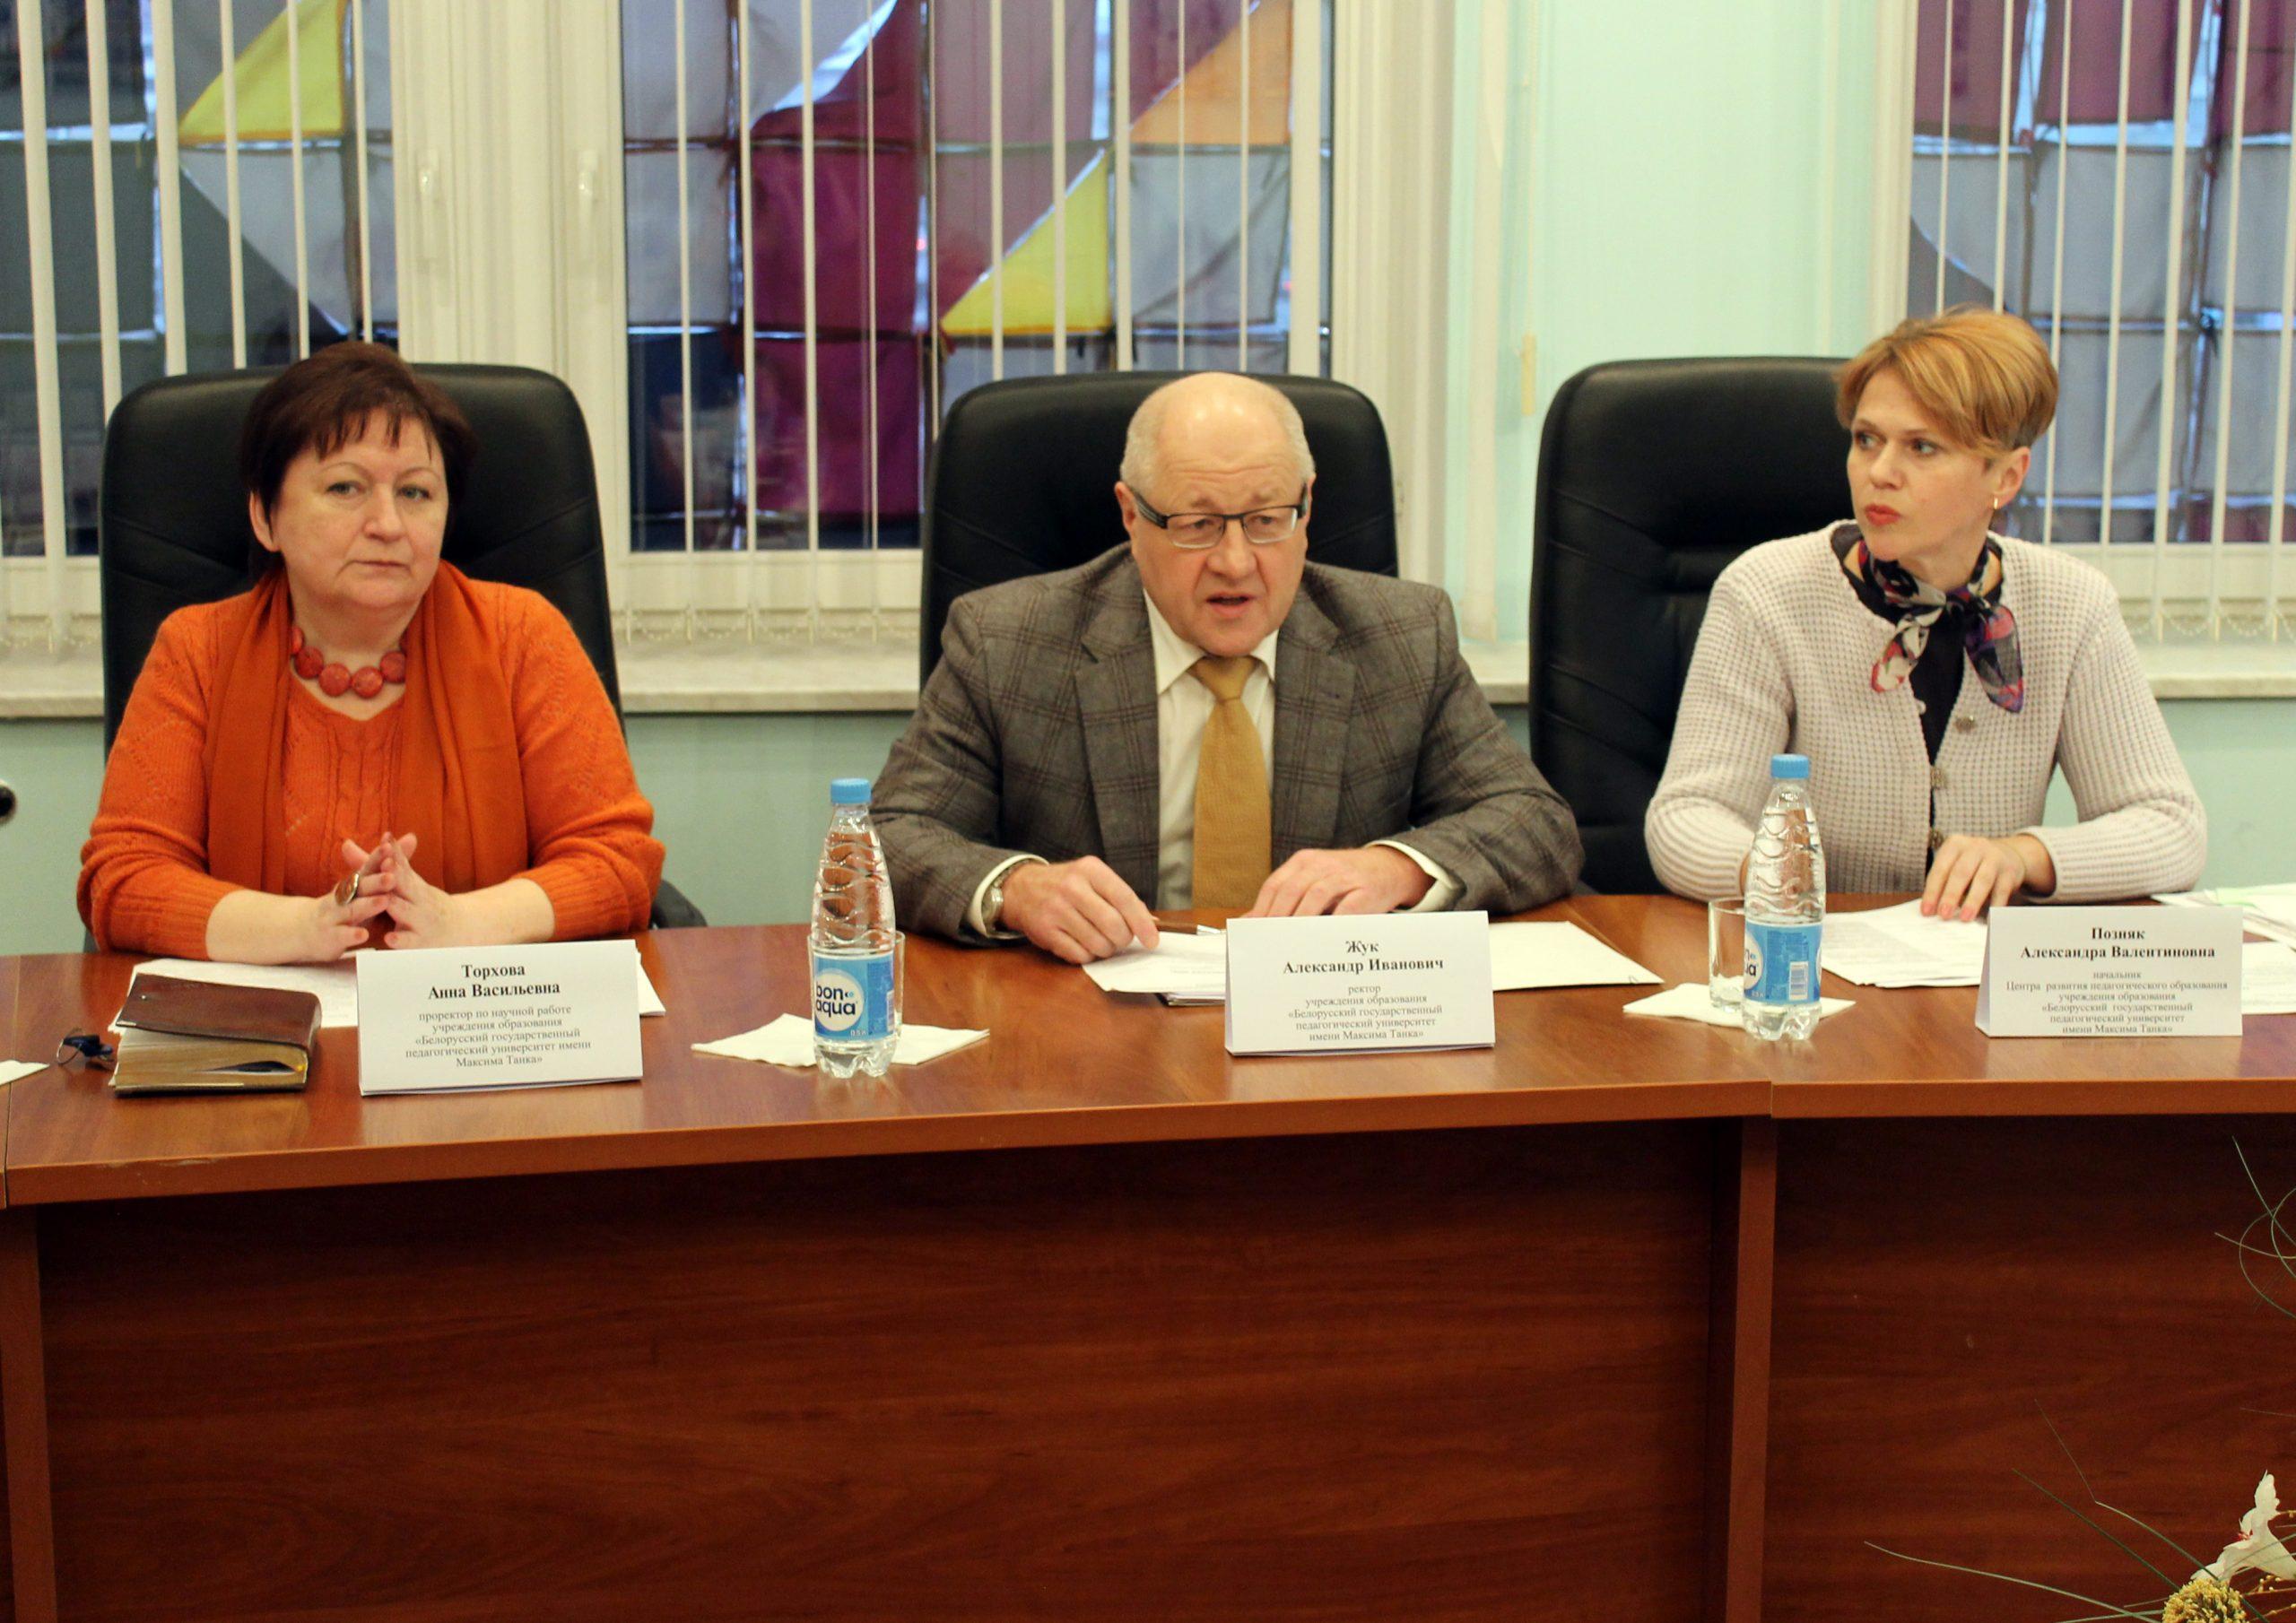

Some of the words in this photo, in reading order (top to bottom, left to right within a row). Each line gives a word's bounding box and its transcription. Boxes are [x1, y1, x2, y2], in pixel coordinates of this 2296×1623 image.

[2092, 928, 2145, 940] Позняк
[1345, 941, 1379, 955] Жук
[2021, 947, 2107, 961] Александра
[2111, 946, 2214, 959] Валентиновна
[461, 965, 526, 980] Торхова
[1283, 961, 1363, 975] Александр
[1370, 959, 1443, 971] Иванович
[2093, 971, 2141, 979] начальник
[428, 985, 466, 1000] Анна
[472, 983, 560, 997] Васильевна
[1348, 985, 1380, 995] ректор
[2006, 982, 2040, 993] Центра
[2046, 983, 2088, 992] развития
[2091, 983, 2168, 992] педагогического
[2170, 980, 2228, 992] образования
[1306, 997, 1364, 1008] учреждения
[1367, 994, 1427, 1006] образования
[2058, 993, 2115, 1002] учреждения
[2118, 992, 2176, 1002] образования
[419, 1011, 473, 1021] проректор
[475, 1010, 489, 1018] по
[491, 1008, 535, 1020] научной
[537, 1005, 571, 1016] работе
[816, 1000, 856, 1018] aqua
[1289, 1009, 1356, 1020] «Белорусский
[1359, 1005, 1442, 1018] государственный
[2042, 1002, 2107, 1014] «Белорусский
[2113, 1002, 2193, 1014] государственный
[432, 1021, 494, 1033] учреждения
[498, 1018, 562, 1030] образования
[1296, 1019, 1373, 1031] педагогический
[1376, 1018, 1436, 1029] университет
[2050, 1014, 2124, 1025] педагогический
[2126, 1015, 2185, 1024] университет
[1309, 1033, 1340, 1041] имени
[1343, 1030, 1387, 1040] Максима
[1391, 1030, 1423, 1039] Танка»
[2095, 1024, 2137, 1033] Максима
[2140, 1024, 2172, 1033] Танка»
[416, 1033, 488, 1046] «Белорусский
[491, 1028, 579, 1043] государственный
[405, 1046, 488, 1059] педагогический
[491, 1044, 556, 1055] университет
[559, 1041, 591, 1049] имени
[457, 1056, 503, 1067] Максима
[508, 1055, 542, 1065] Танка»
